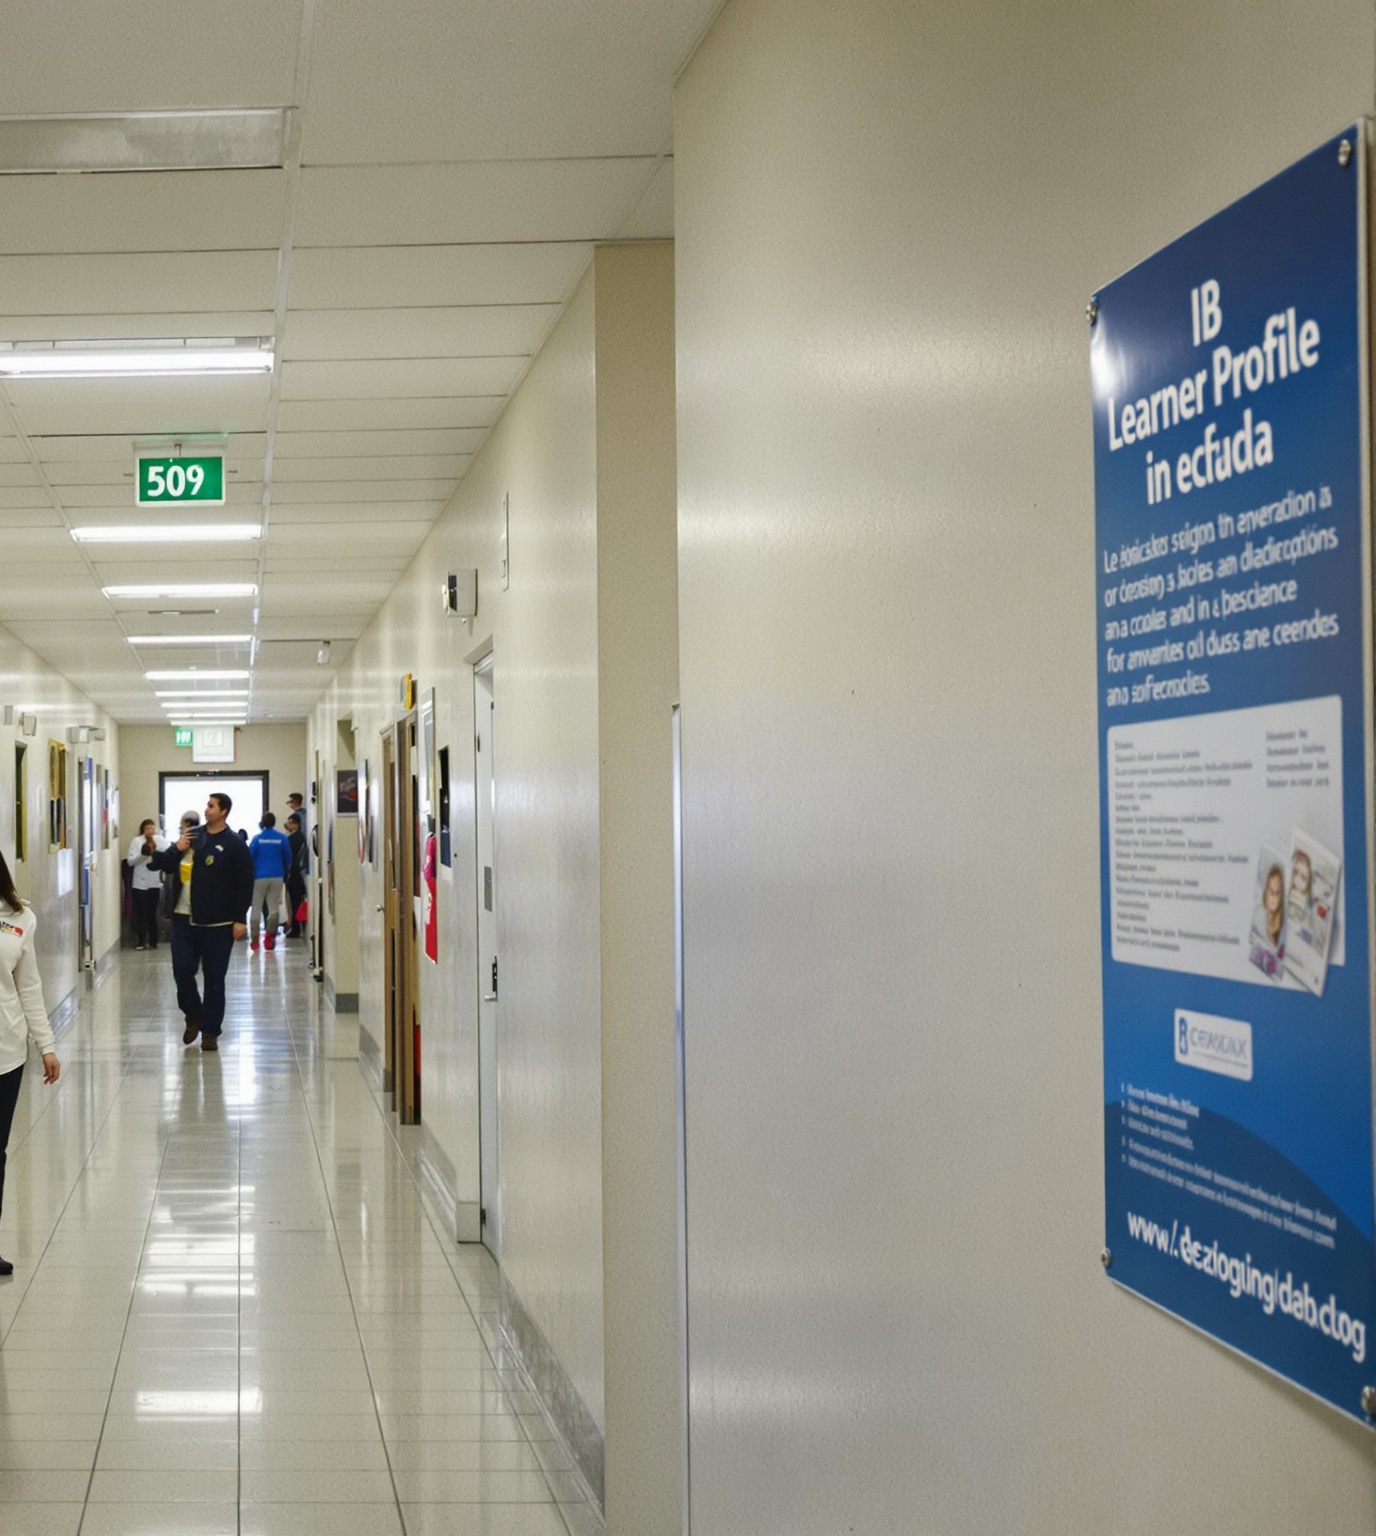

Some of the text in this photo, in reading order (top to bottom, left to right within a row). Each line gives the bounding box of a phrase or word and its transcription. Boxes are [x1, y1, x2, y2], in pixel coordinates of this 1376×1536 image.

[1191, 278, 1222, 347] IB
[1108, 306, 1320, 451] Learner Profile
[147, 464, 205, 497] 509
[1146, 450, 1171, 505] in
